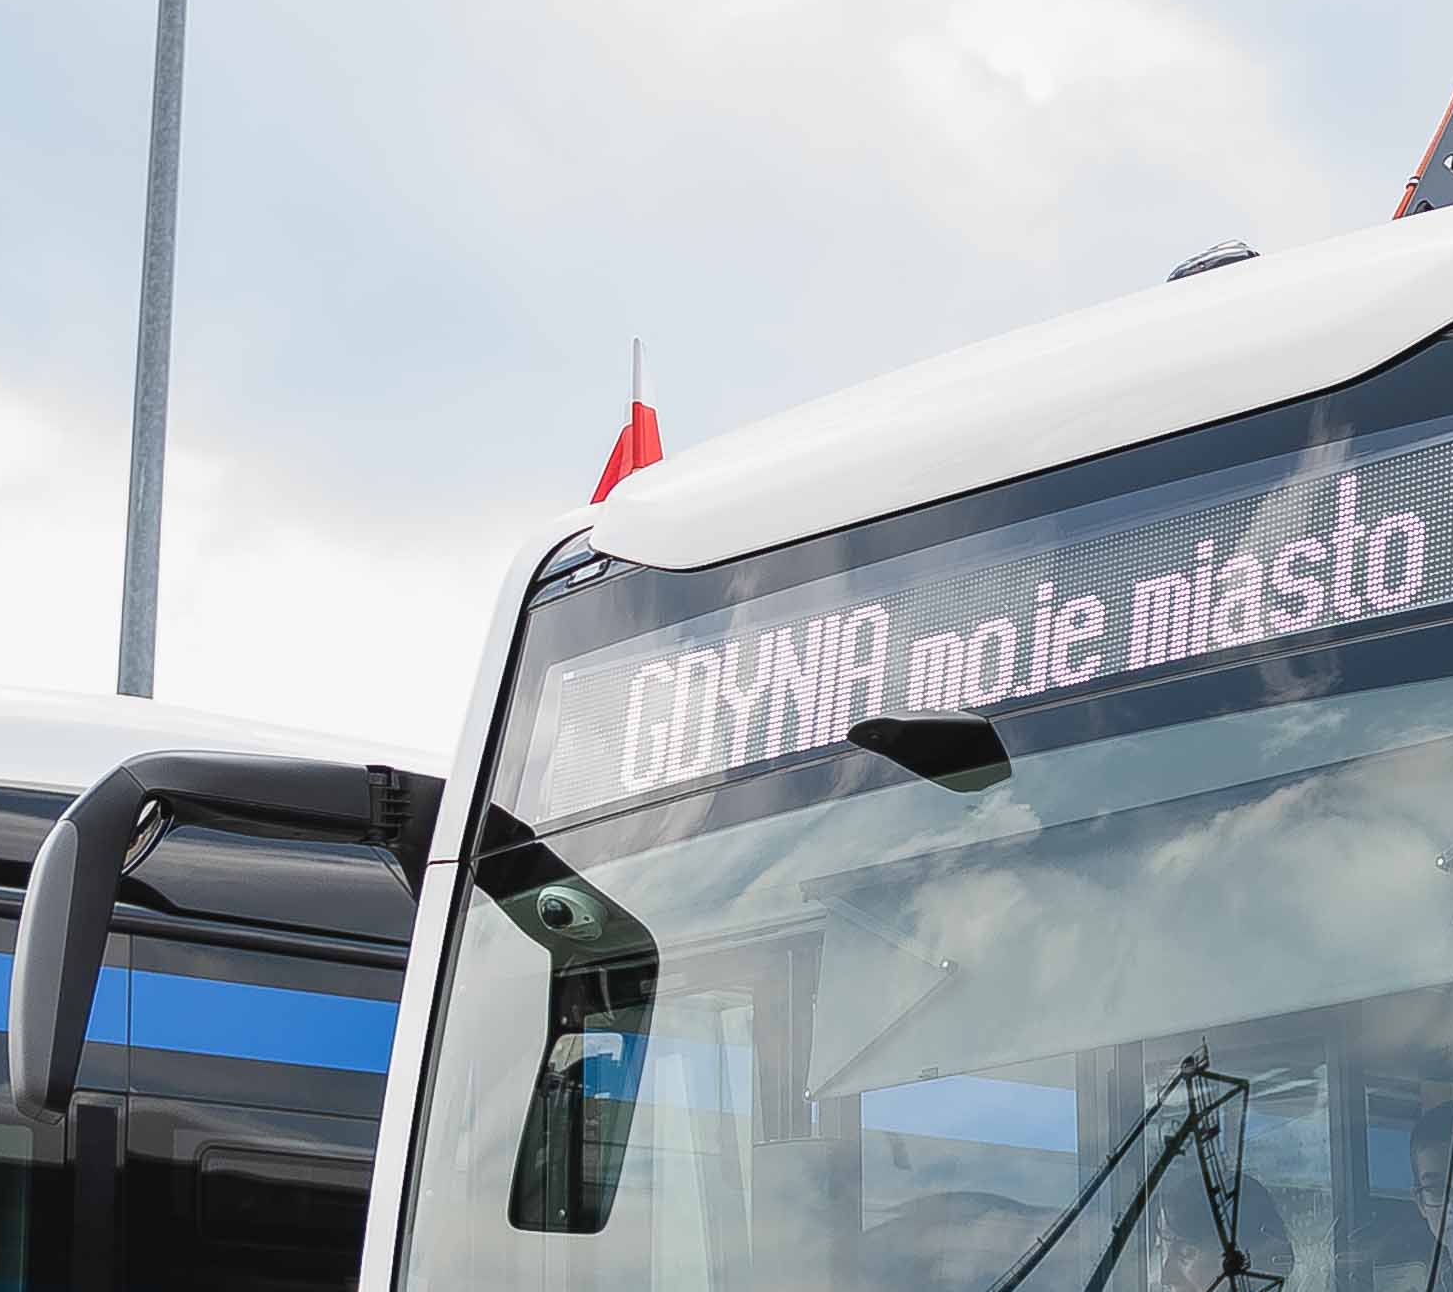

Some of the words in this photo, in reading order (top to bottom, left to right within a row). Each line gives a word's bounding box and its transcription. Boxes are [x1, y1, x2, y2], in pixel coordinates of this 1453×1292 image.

[619, 604, 889, 794] GDYNIA
[907, 583, 1106, 713] moje
[1128, 474, 1427, 670] miasto
